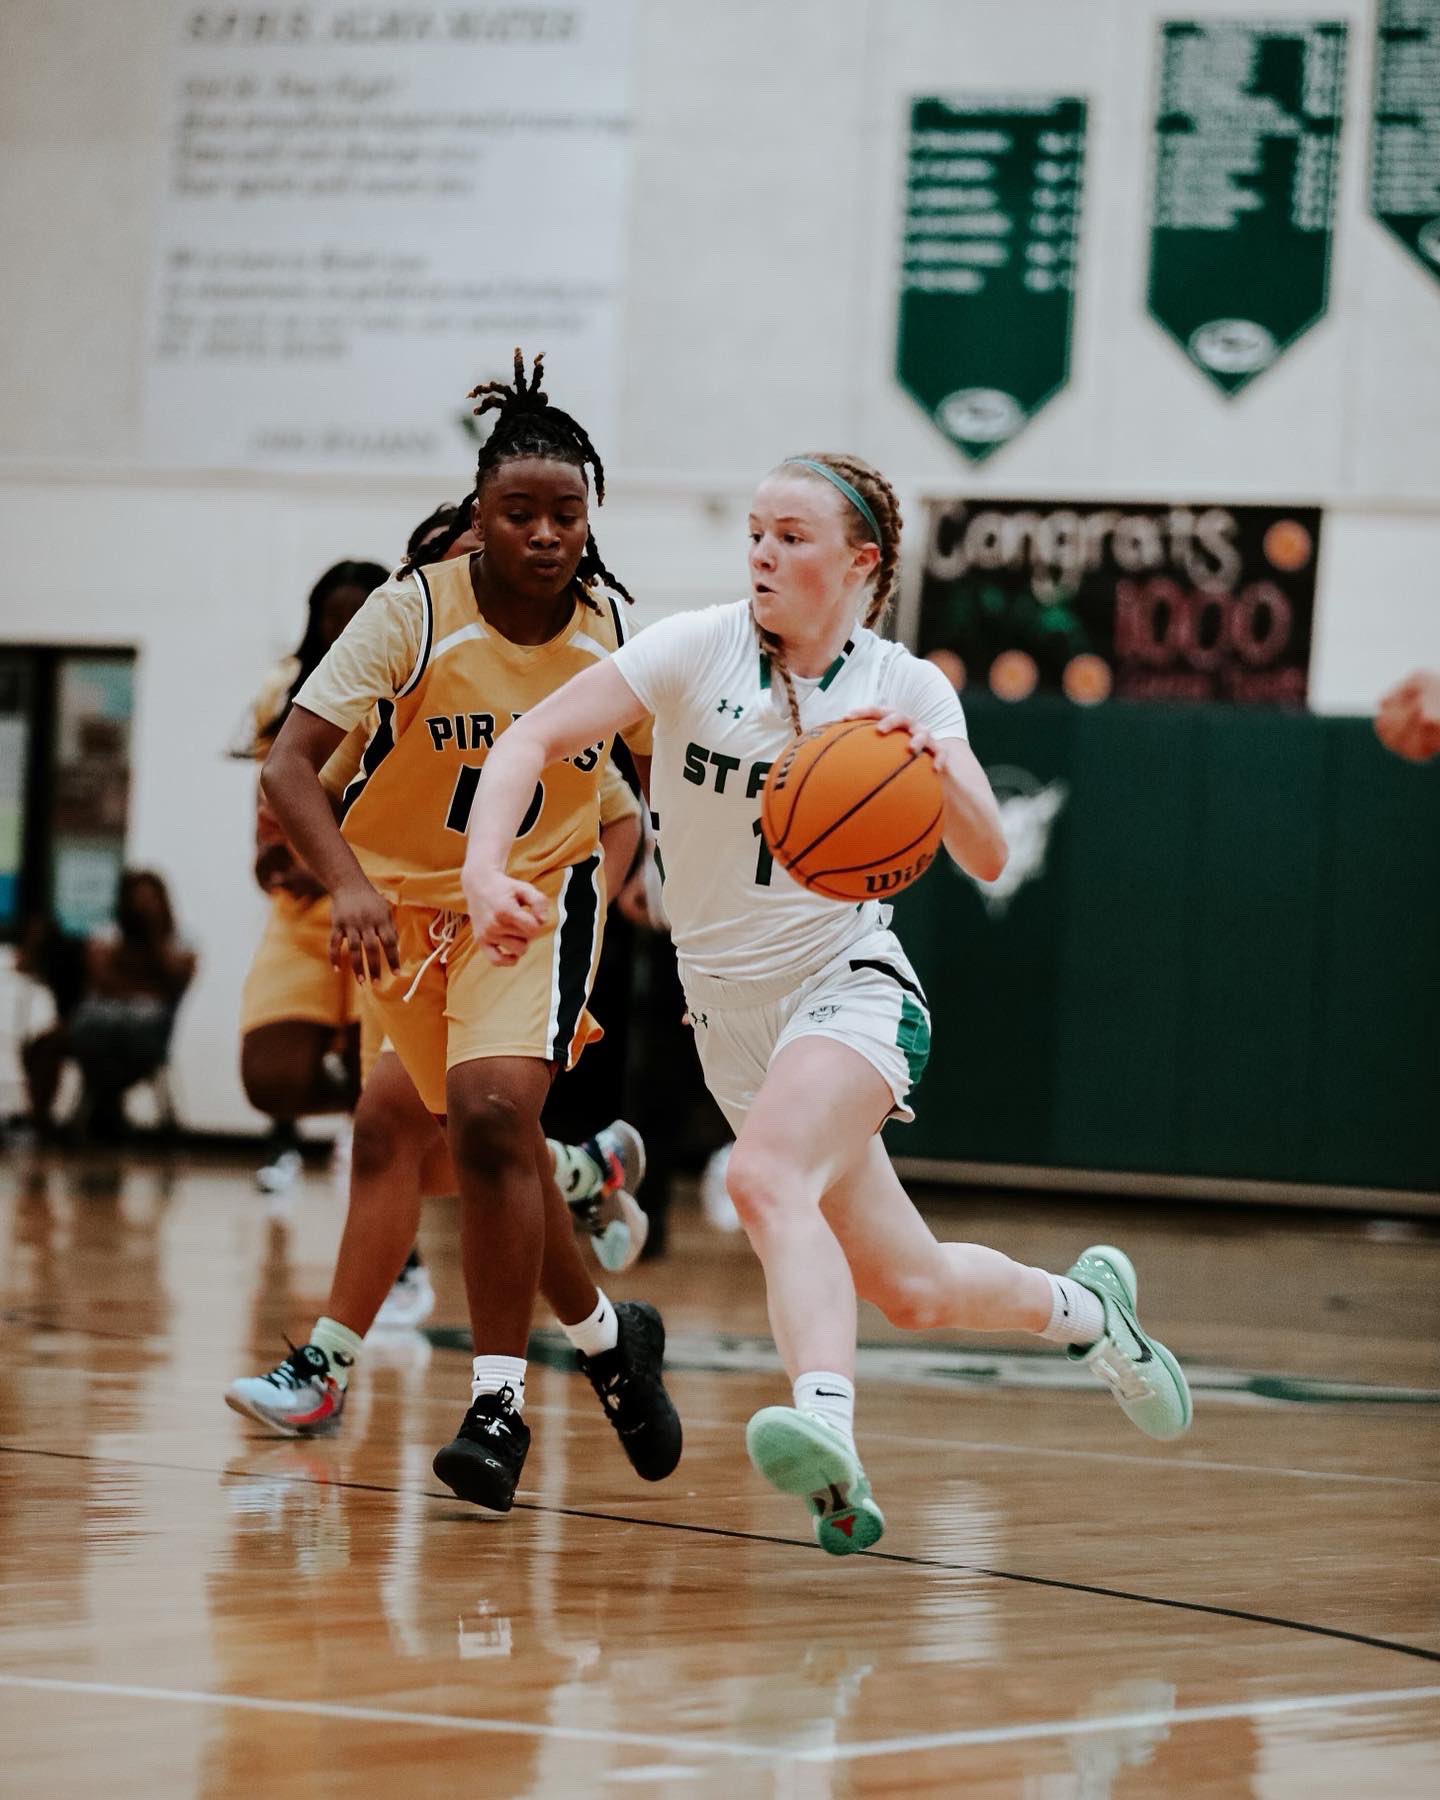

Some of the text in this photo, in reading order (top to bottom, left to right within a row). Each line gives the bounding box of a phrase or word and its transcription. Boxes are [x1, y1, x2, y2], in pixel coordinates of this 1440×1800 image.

[927, 500, 1242, 604] Congrats
[1114, 576, 1293, 669] 1000
[425, 712, 605, 773] PIRS
[682, 741, 775, 798] STA
